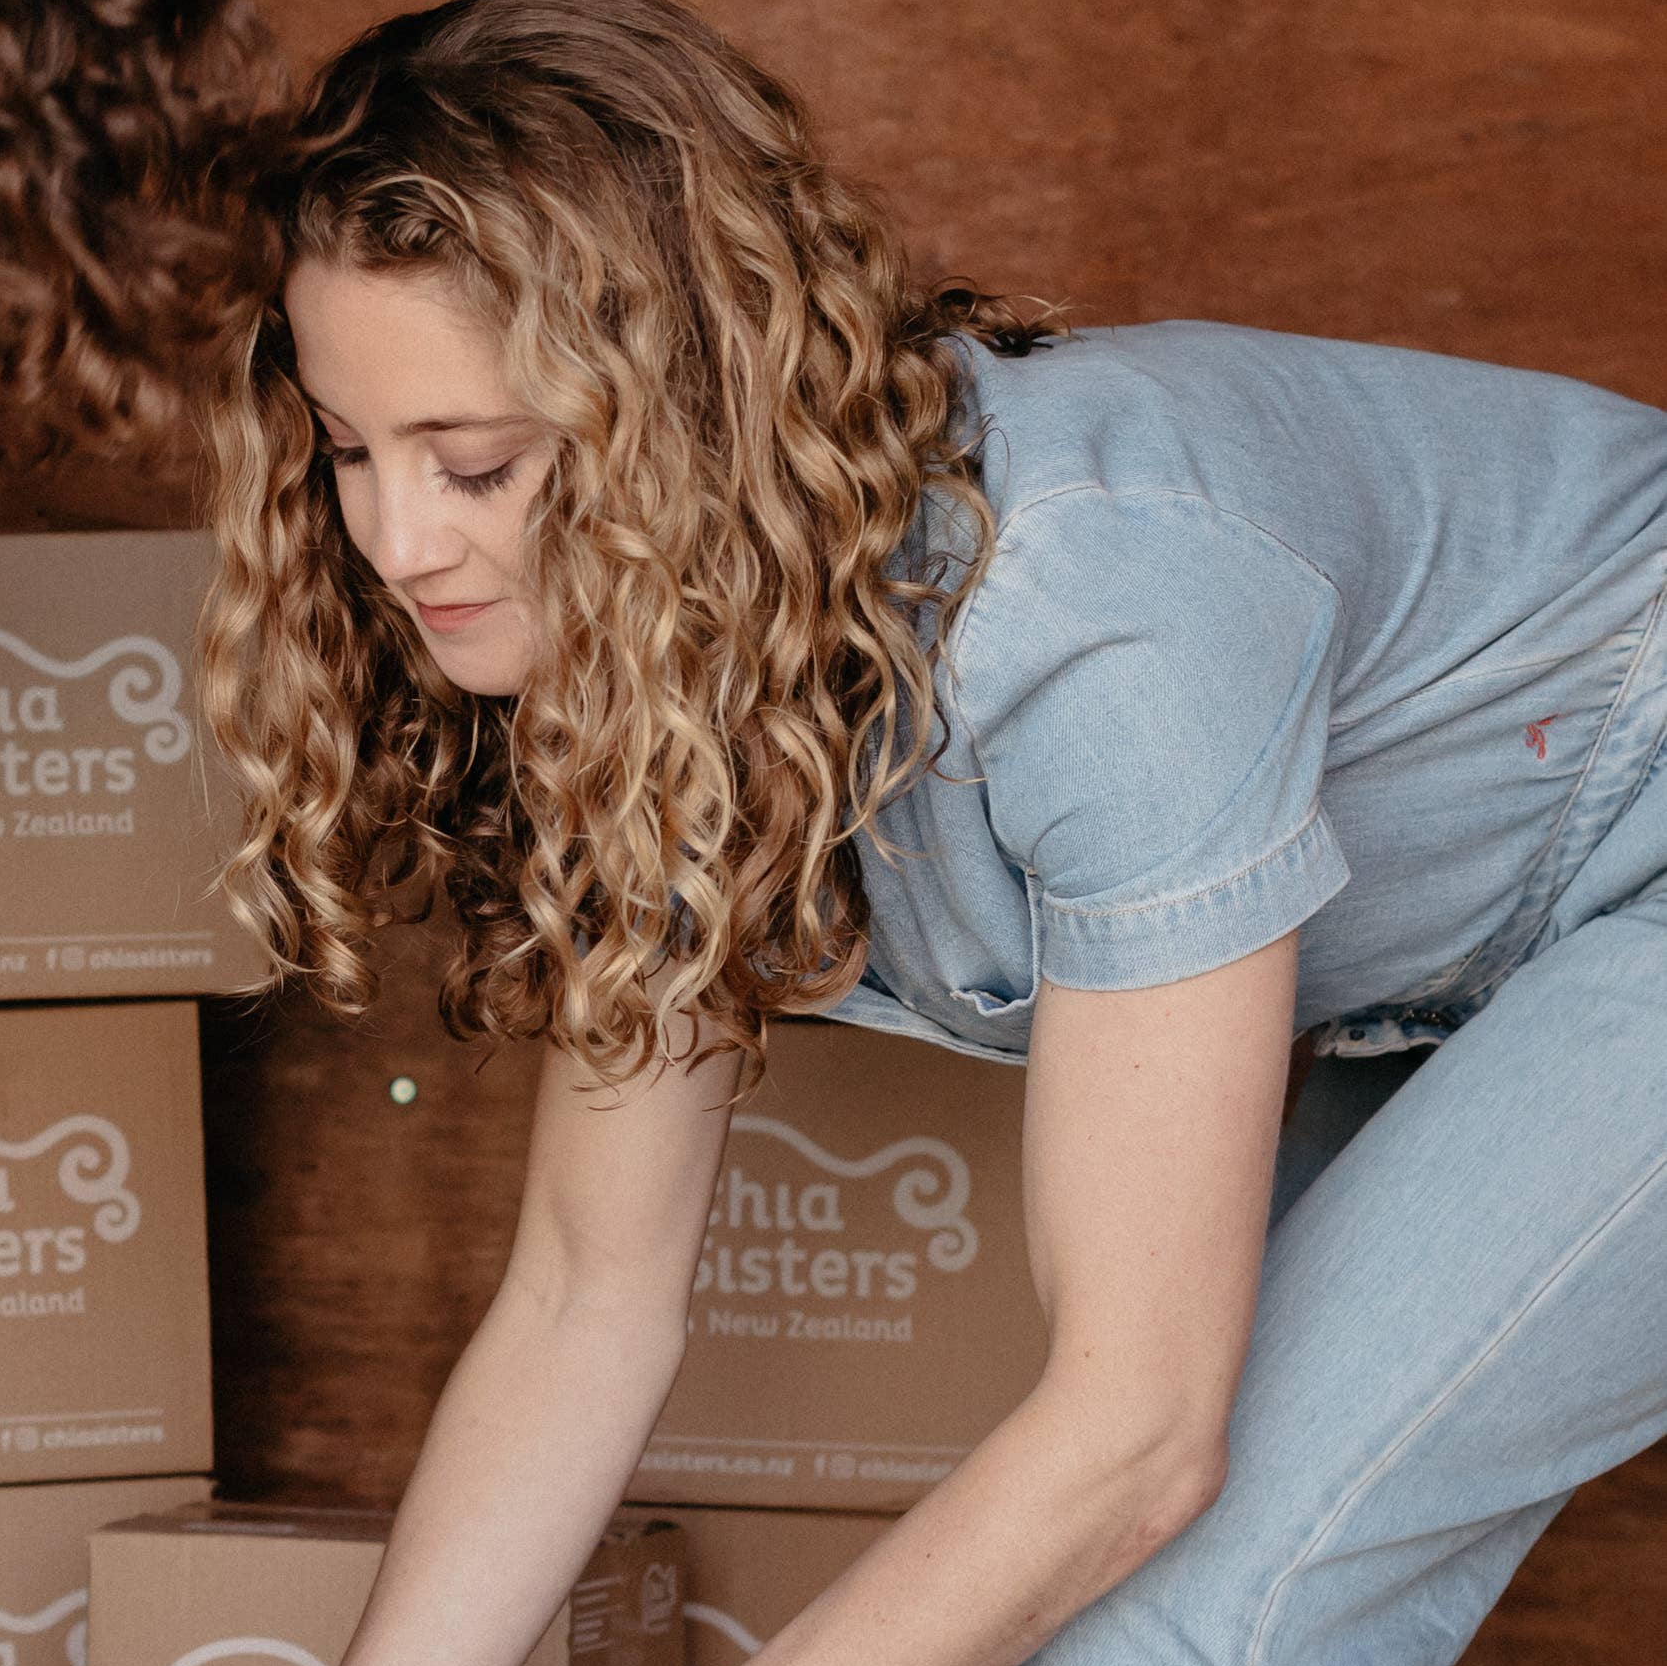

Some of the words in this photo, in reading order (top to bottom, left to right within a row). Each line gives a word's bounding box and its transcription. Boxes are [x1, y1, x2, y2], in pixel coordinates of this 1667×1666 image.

[14, 808, 134, 837] Zealand
[708, 1309, 778, 1336] New
[788, 1312, 913, 1342] Zealand
